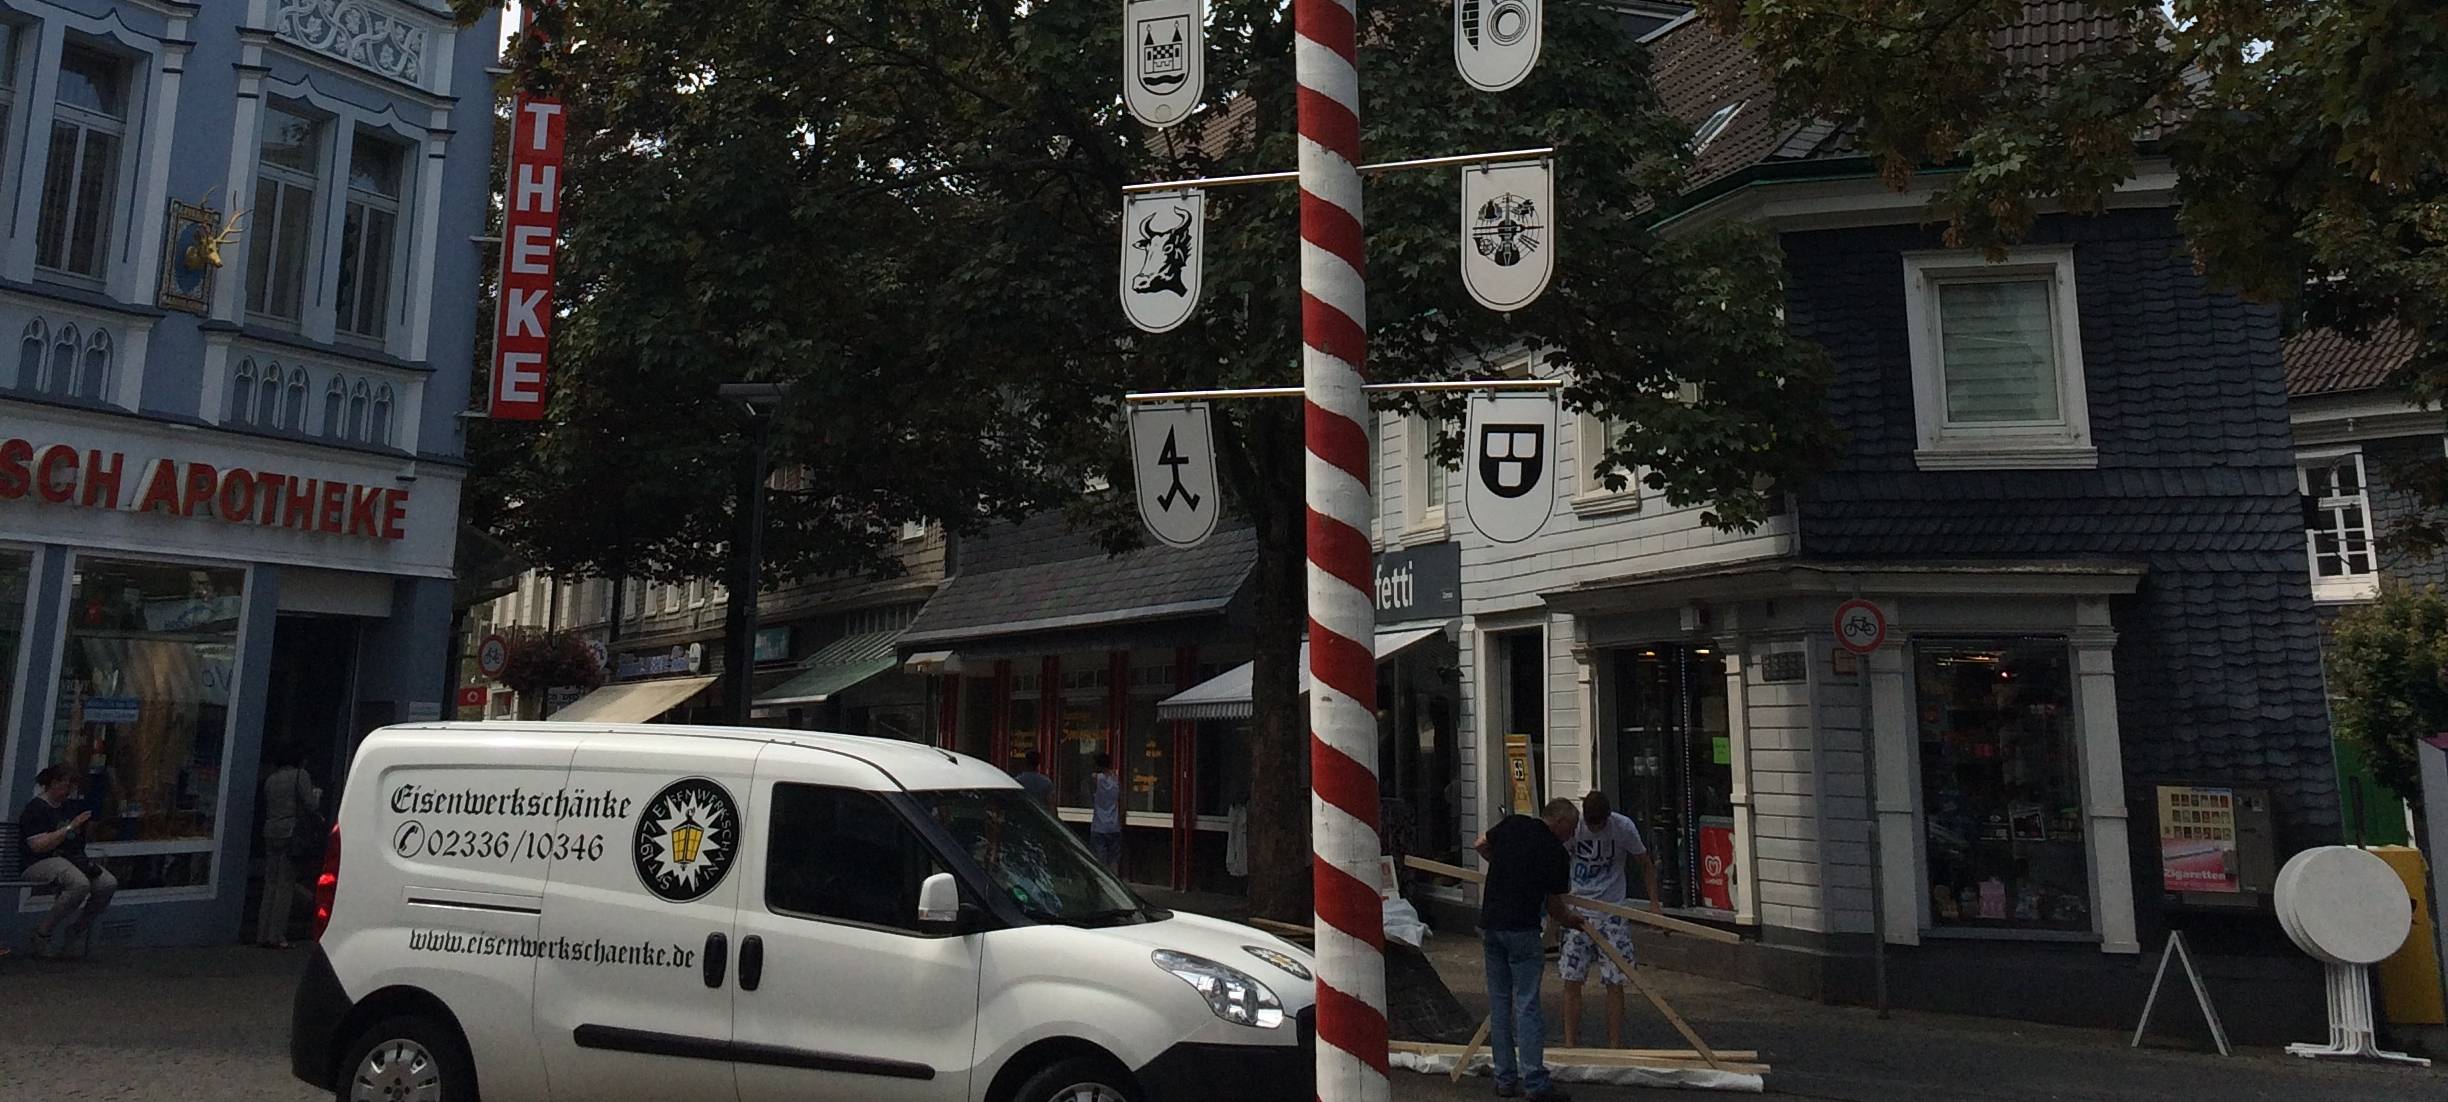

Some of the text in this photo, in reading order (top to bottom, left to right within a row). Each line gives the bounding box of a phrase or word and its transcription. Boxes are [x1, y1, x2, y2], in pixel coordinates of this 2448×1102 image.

[139, 460, 409, 537] APOTHEKE
[1374, 560, 1414, 610] fetti
[391, 784, 632, 821] Eisenwerkschänke
[426, 832, 605, 864] 02336/10346
[2164, 868, 2227, 882] Zigaretten
[409, 929, 695, 968] www.eisenwerkschaenke.de
